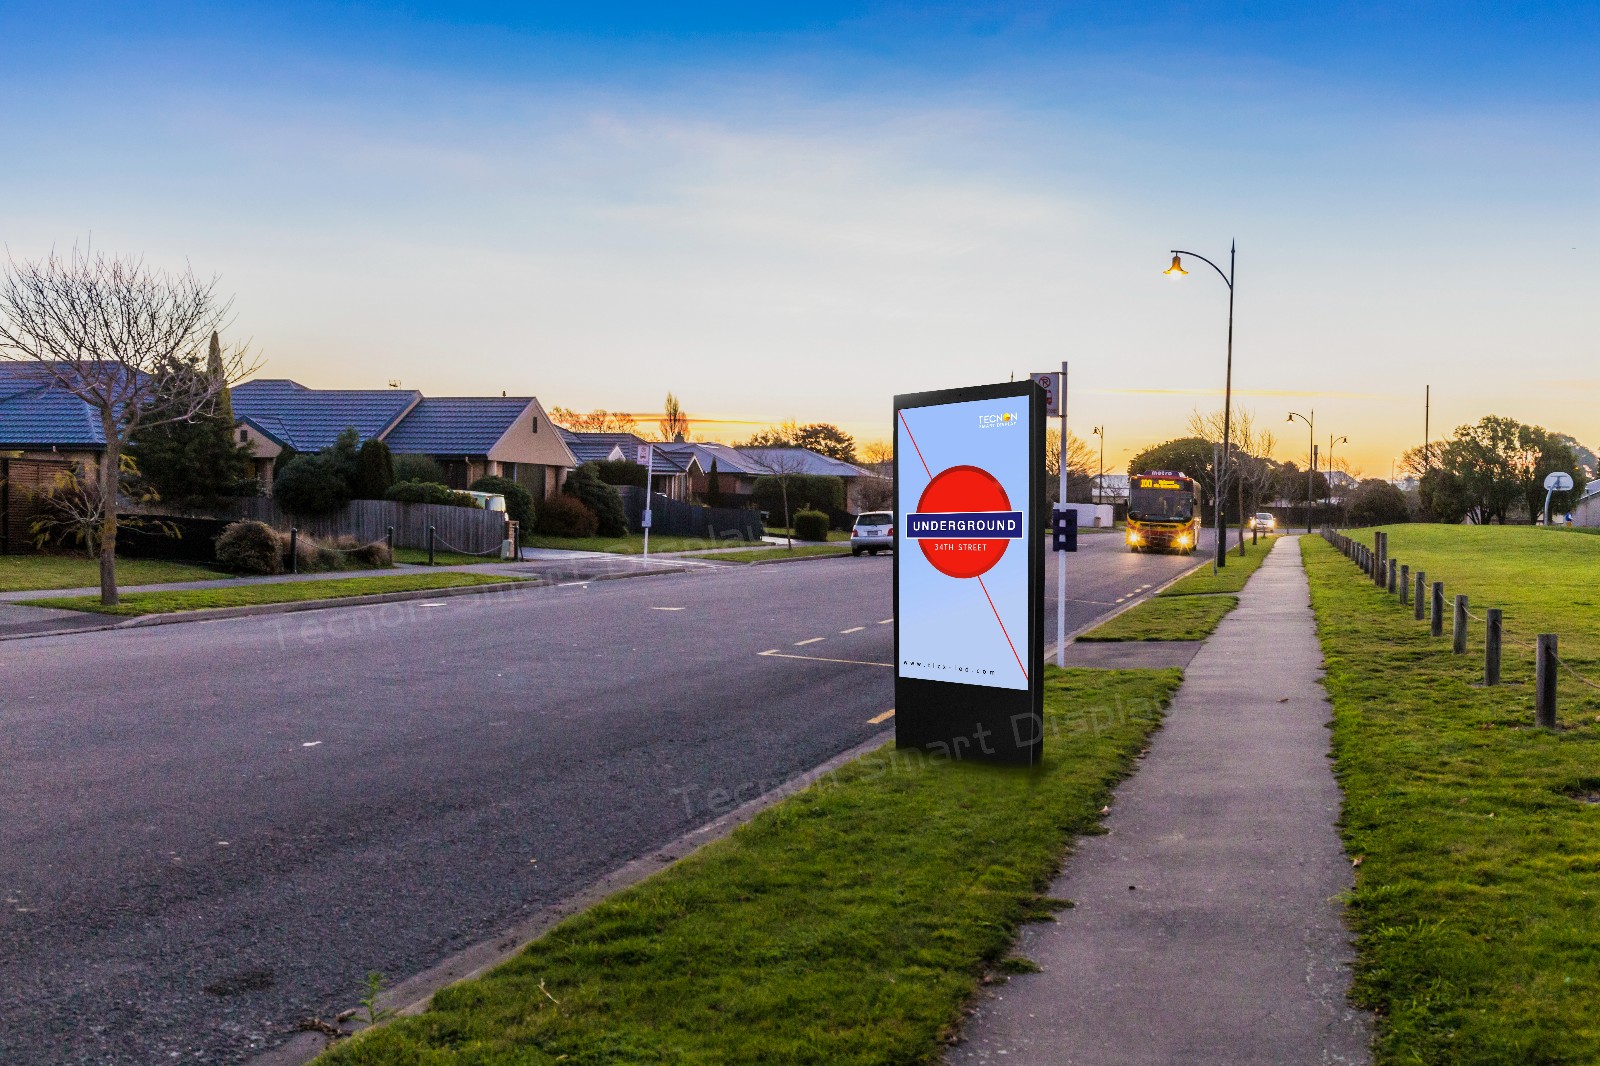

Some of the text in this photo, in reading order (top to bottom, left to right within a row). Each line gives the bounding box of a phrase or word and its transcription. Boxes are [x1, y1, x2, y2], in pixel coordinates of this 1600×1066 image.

[978, 412, 1018, 424] TECNON
[913, 519, 1016, 531] UNDERGROUND
[934, 543, 987, 551] 34TH STREET
